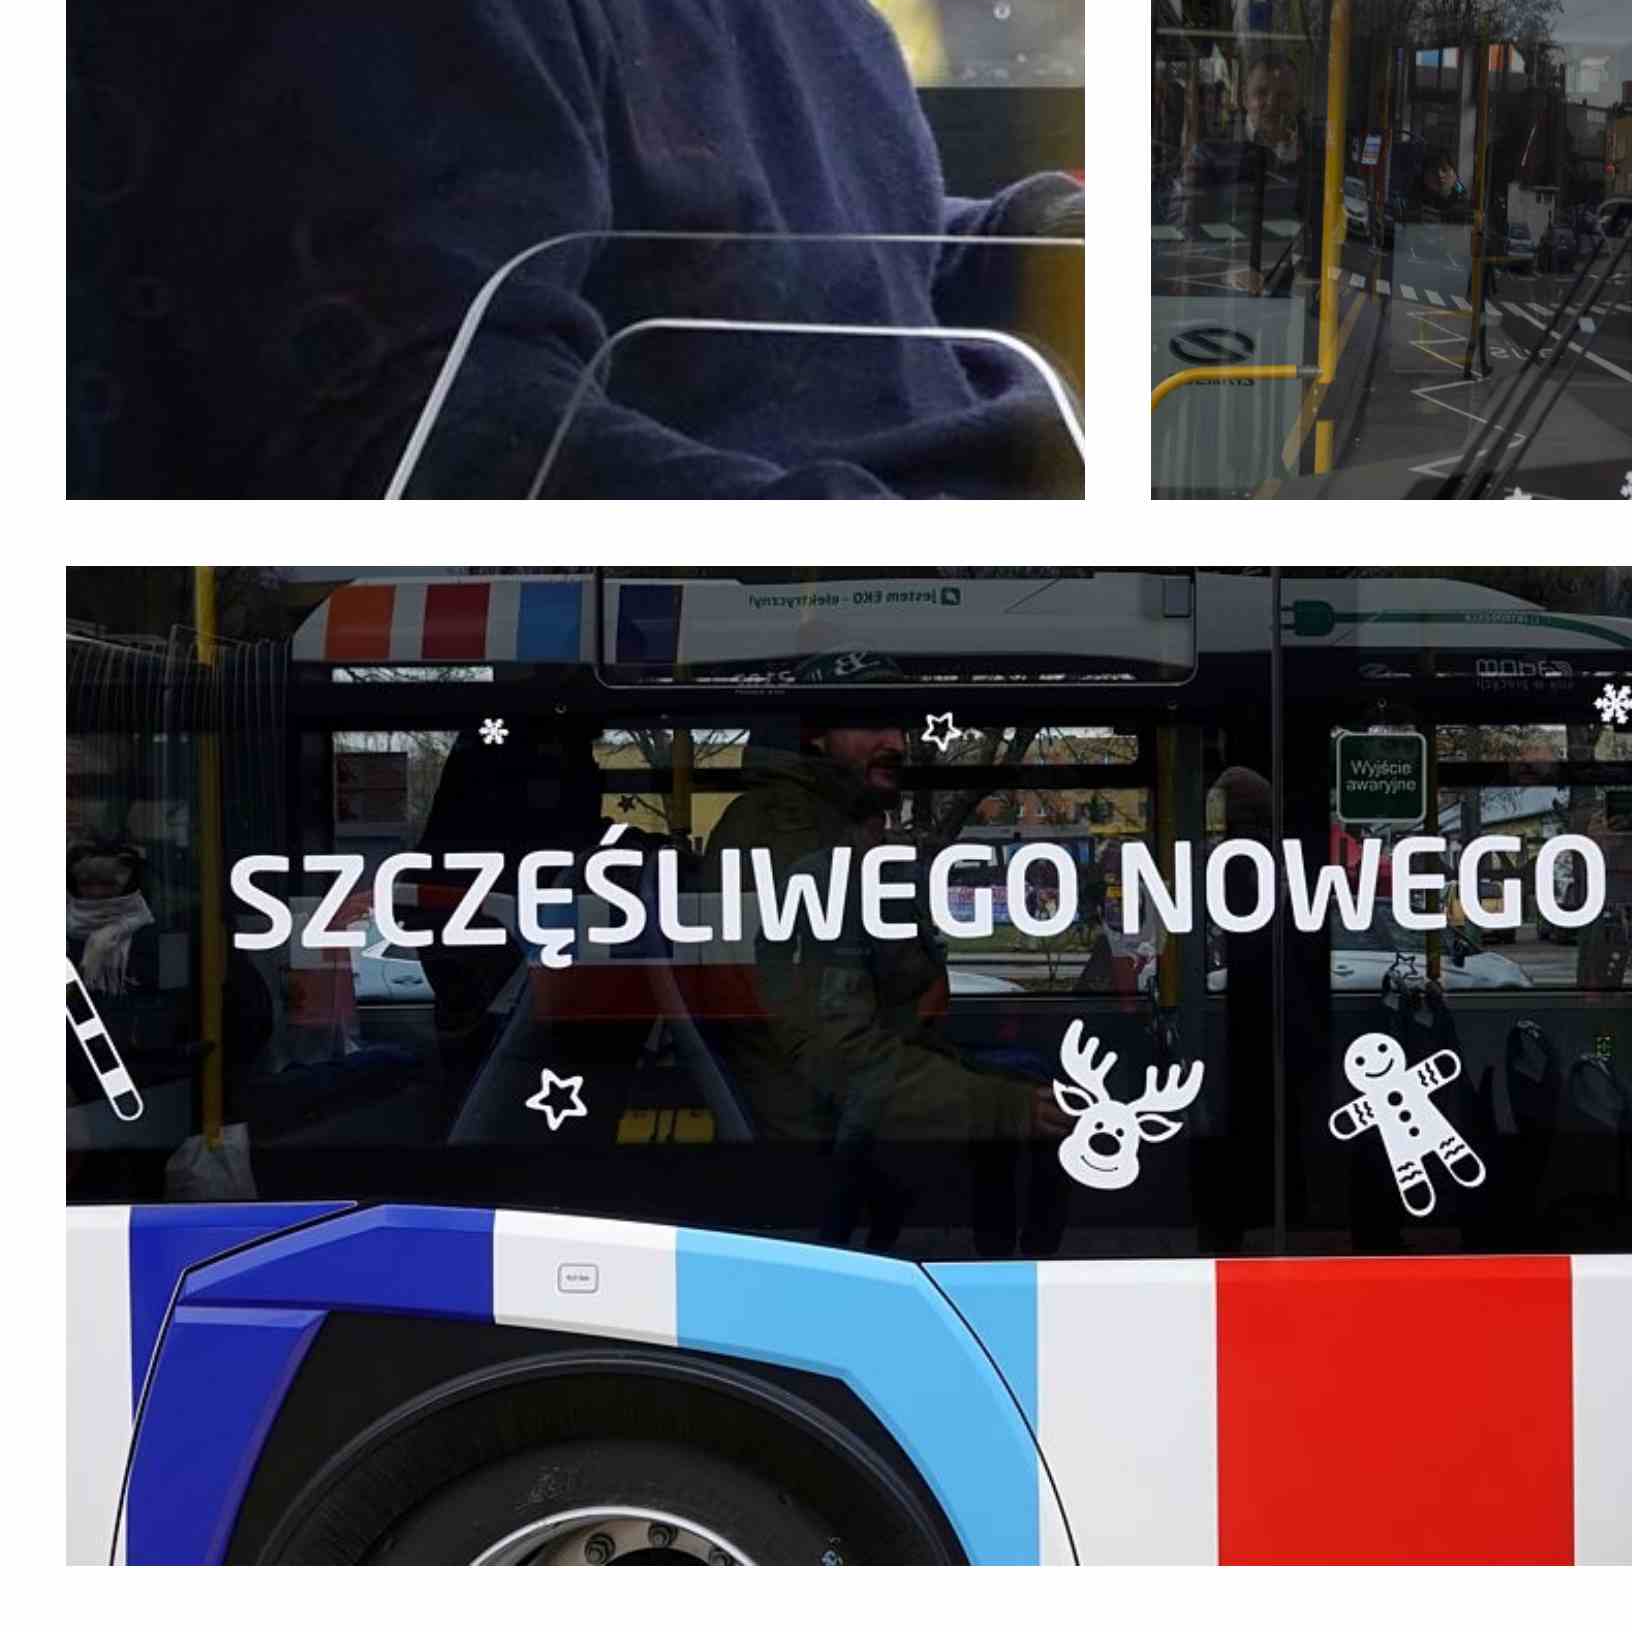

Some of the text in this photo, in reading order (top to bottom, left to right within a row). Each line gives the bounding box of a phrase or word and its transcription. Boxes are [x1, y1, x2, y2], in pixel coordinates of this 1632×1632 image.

[1349, 759, 1412, 778] Wyjście
[1343, 777, 1417, 795] awaryjne
[230, 823, 1080, 969] SZCZĘŚLIWEGO
[1120, 832, 1607, 936] NOWEGO
